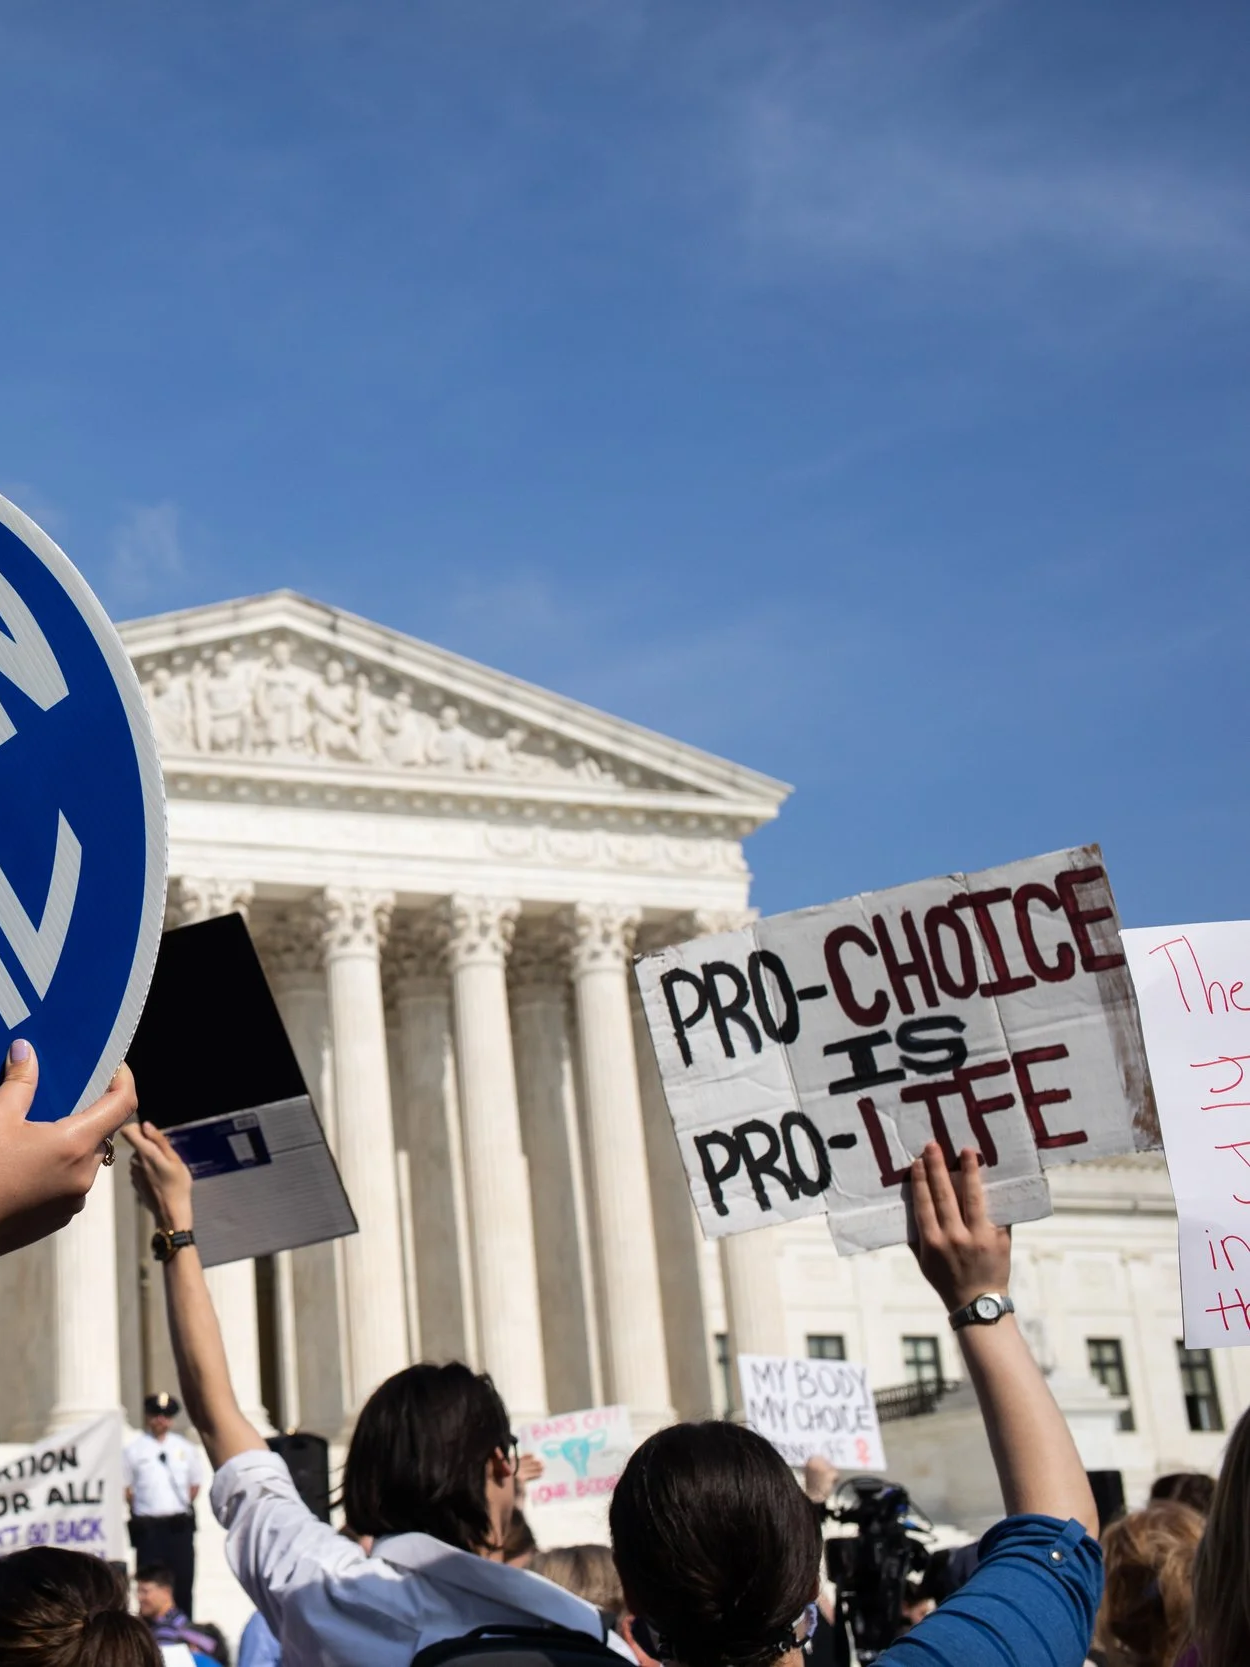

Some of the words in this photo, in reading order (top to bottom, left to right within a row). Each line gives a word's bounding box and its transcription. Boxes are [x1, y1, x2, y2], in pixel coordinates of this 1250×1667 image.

[660, 866, 1126, 1068] PRO-CHOICE
[1149, 935, 1250, 1014] The
[823, 1014, 967, 1095] IS
[694, 1044, 1088, 1216] PRO-LIFE
[750, 1359, 787, 1395] MY
[794, 1359, 869, 1406] BODY
[748, 1396, 788, 1434] MY
[792, 1399, 874, 1434] CHOICE
[47, 1479, 105, 1506] ALL!
[54, 1517, 106, 1545] BACK
